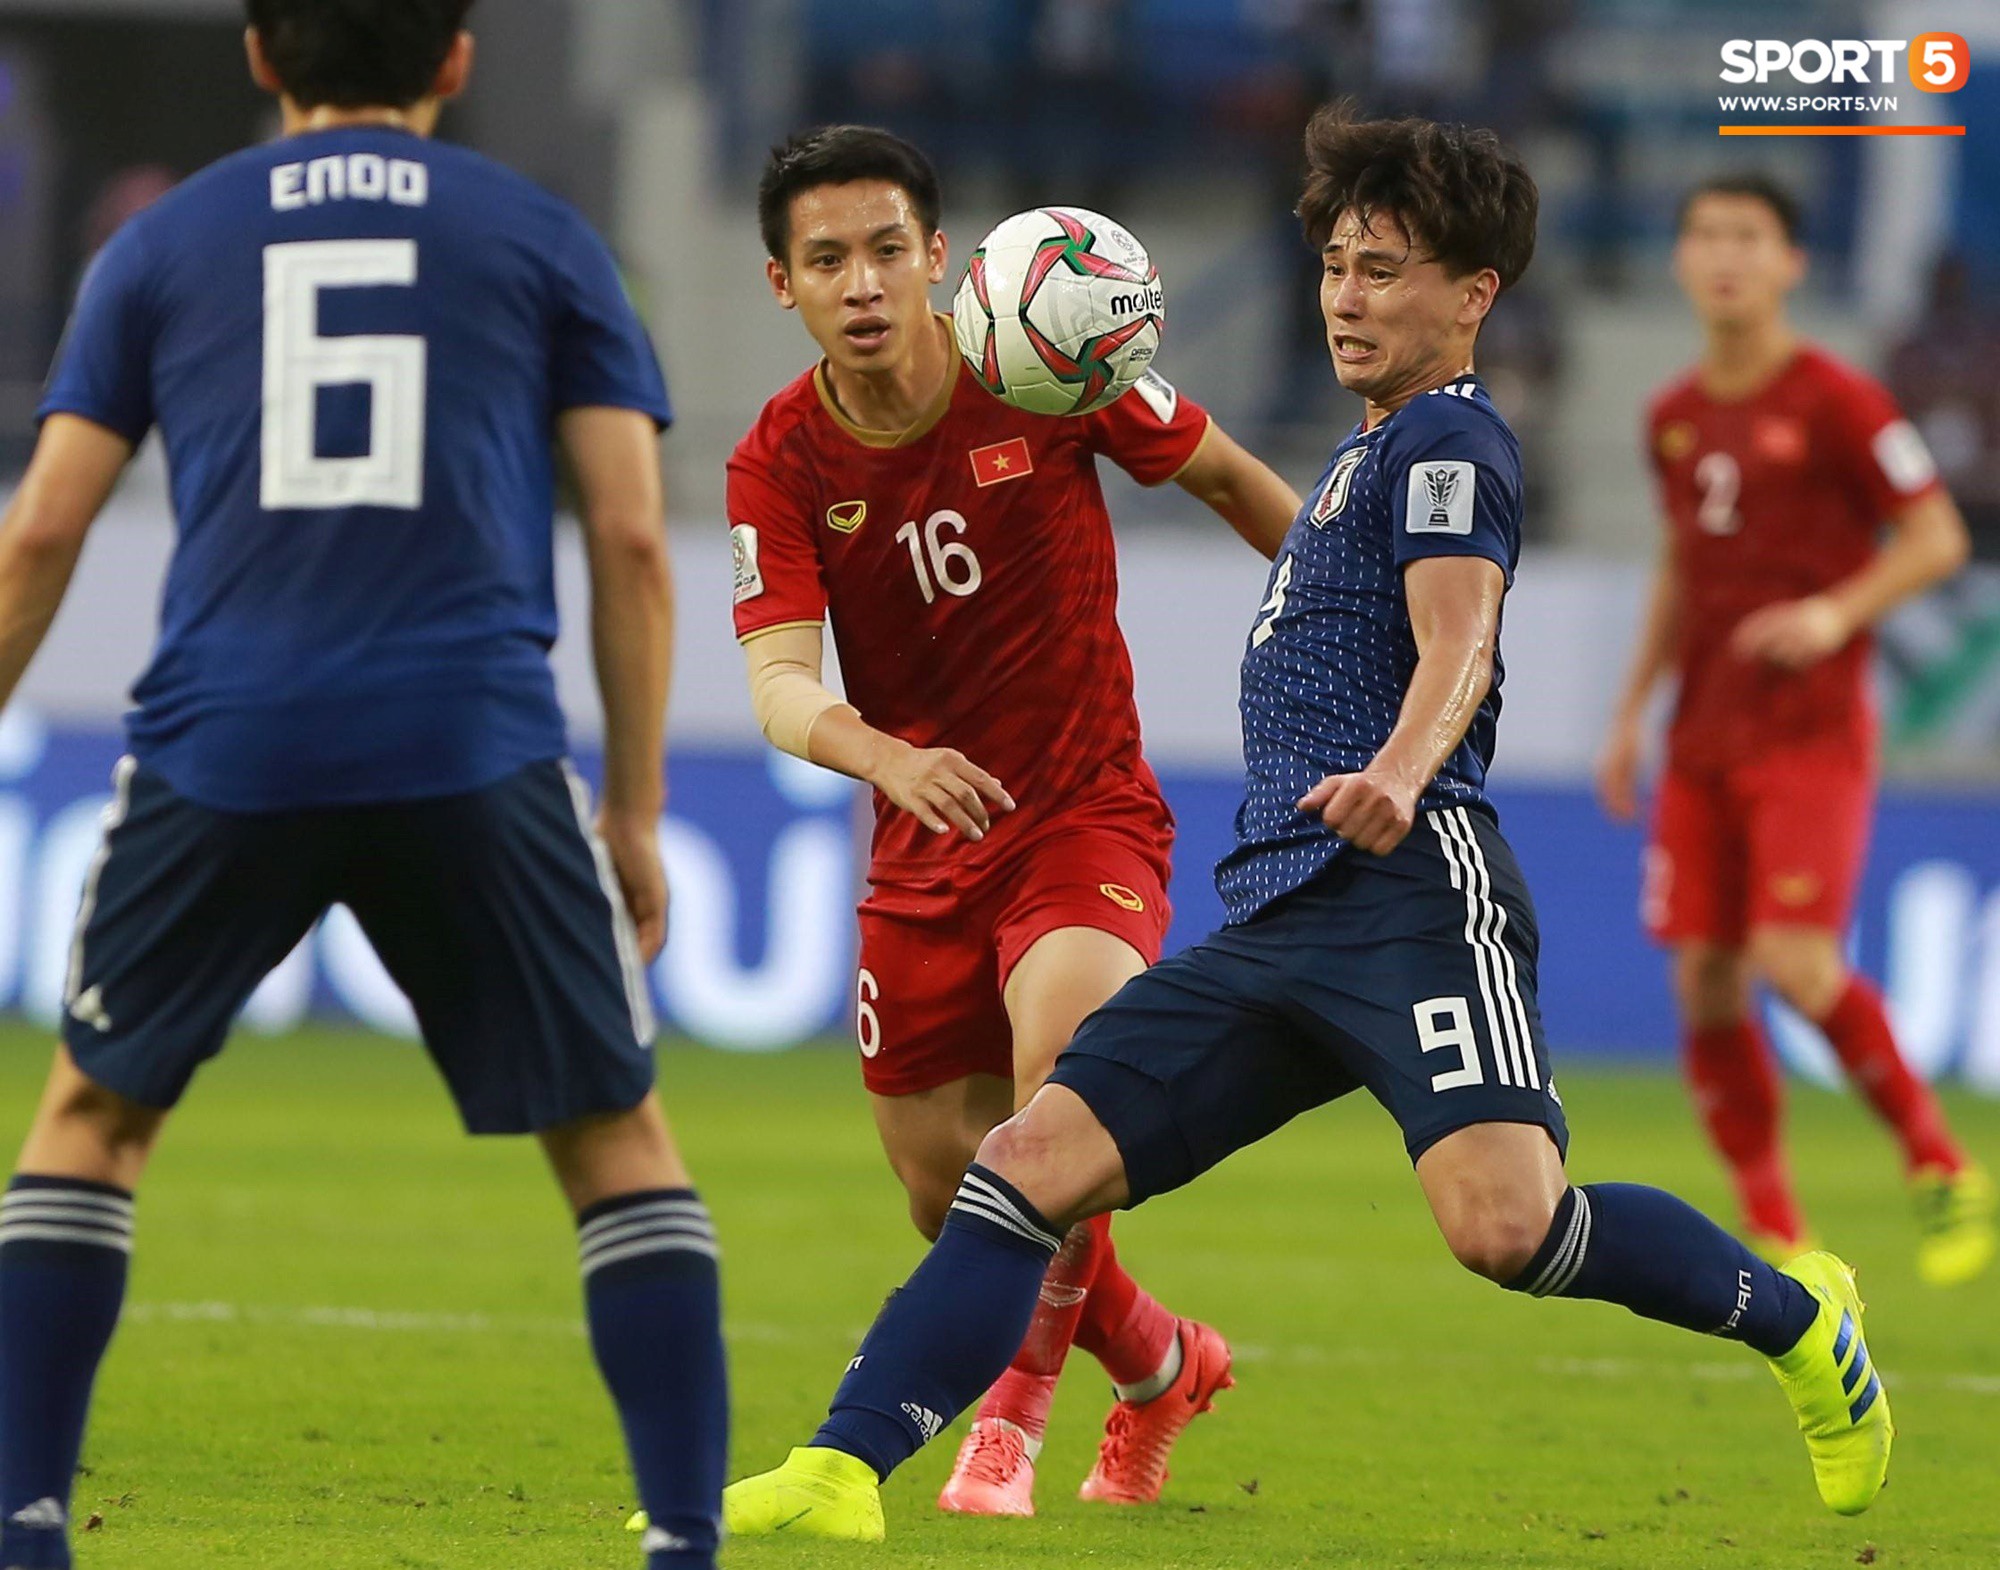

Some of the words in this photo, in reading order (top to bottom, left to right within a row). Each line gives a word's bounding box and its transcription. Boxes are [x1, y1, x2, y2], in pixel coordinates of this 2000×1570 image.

[1110, 287, 1163, 315] molte
[260, 238, 427, 511] 6
[1694, 451, 1745, 537] 2
[895, 509, 983, 604] 16
[1412, 997, 1484, 1093] 9
[1715, 1269, 1752, 1332] PAN
[900, 1402, 931, 1443] adida
